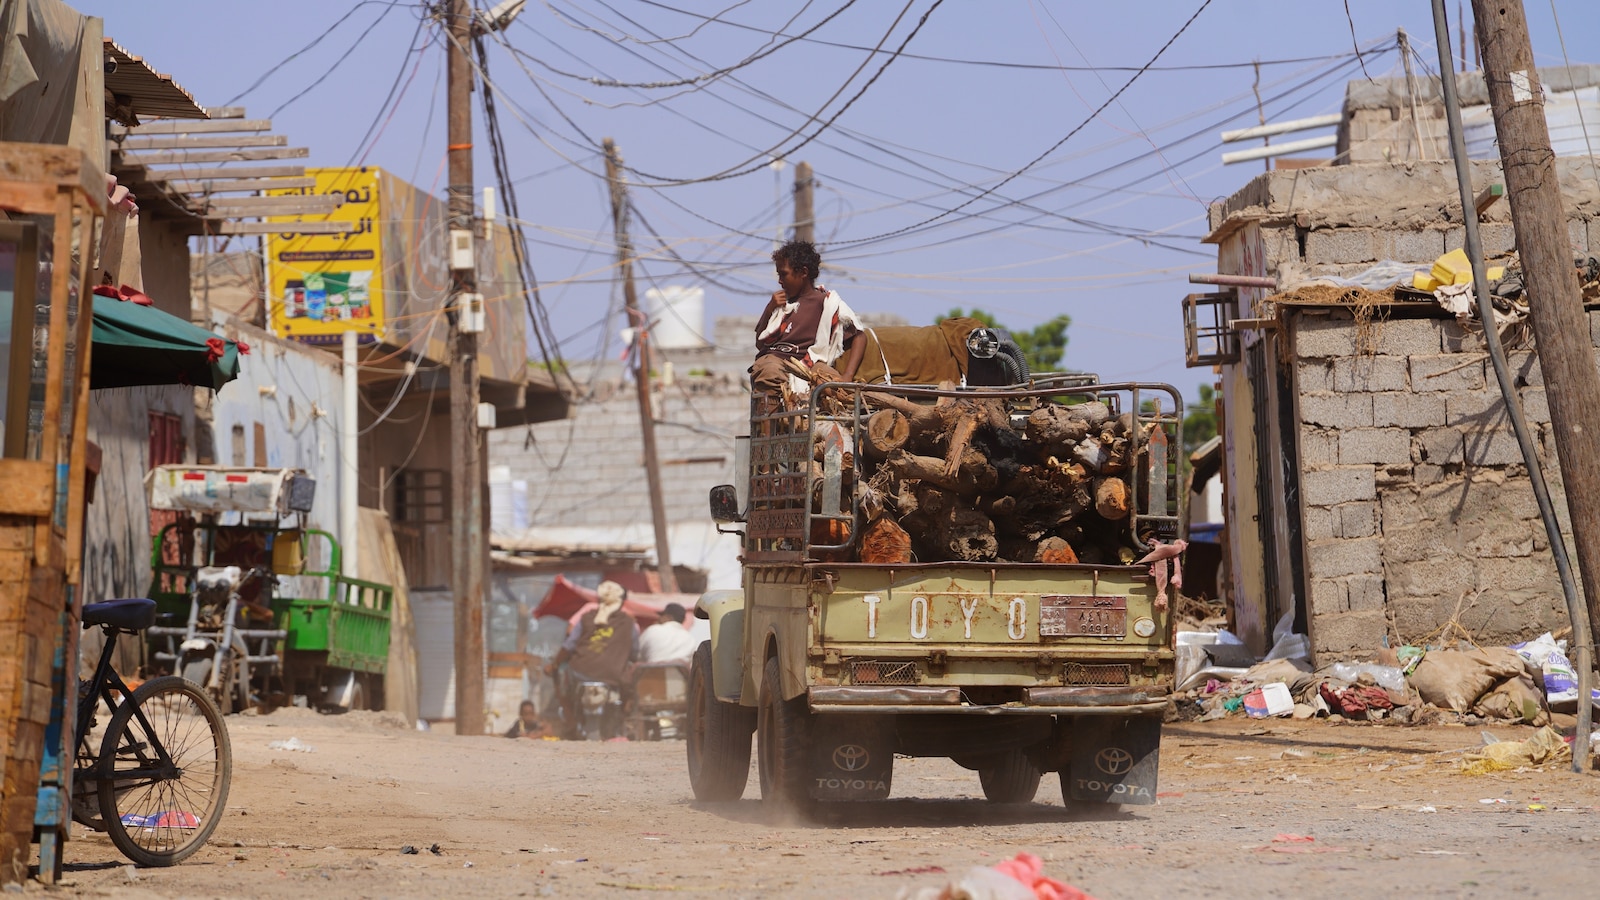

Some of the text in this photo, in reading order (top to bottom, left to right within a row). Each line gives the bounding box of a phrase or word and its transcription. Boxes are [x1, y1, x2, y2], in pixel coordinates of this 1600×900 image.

[1080, 623, 1109, 634] 8491
[815, 778, 887, 791] TOYOTA
[1077, 779, 1152, 798] TOYOTA
